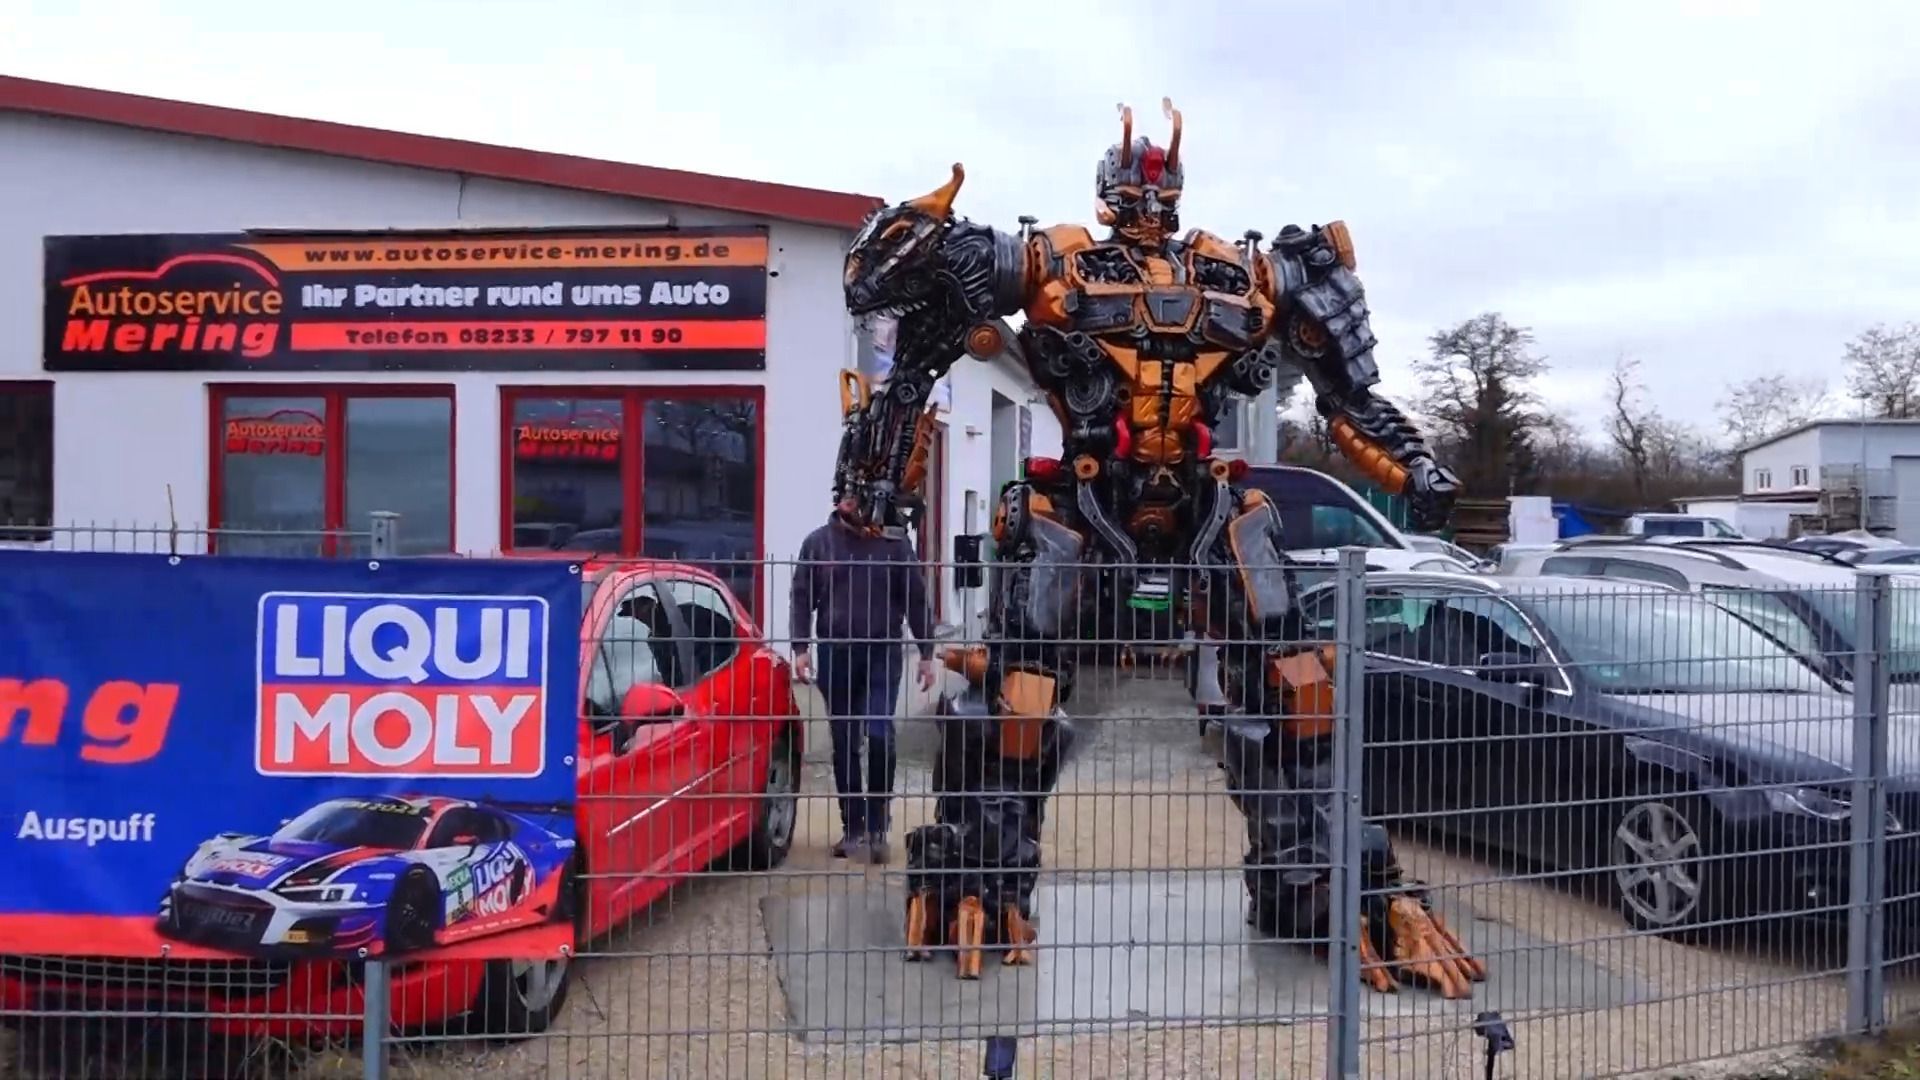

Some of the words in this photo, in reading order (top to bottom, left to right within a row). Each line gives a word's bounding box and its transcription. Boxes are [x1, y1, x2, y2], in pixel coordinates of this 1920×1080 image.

[304, 242, 730, 262] www.autoservice-mering.de
[69, 282, 283, 316] Autoservice
[302, 284, 347, 308] Ihr
[355, 283, 479, 308] Partner
[487, 281, 563, 307] rund
[571, 283, 641, 306] ums
[650, 280, 730, 305] Auto
[61, 316, 280, 357] Mering
[345, 328, 448, 344] Telefon
[459, 328, 535, 344] 08233
[544, 329, 554, 344] /
[565, 328, 611, 344] 797
[620, 328, 642, 343] 11
[652, 328, 683, 343] 90
[228, 421, 325, 438] Autoservice
[520, 424, 619, 441] Autoservice
[275, 603, 531, 684] LIQUI
[273, 691, 537, 767] MOLY
[16, 810, 155, 847] Auspuff
